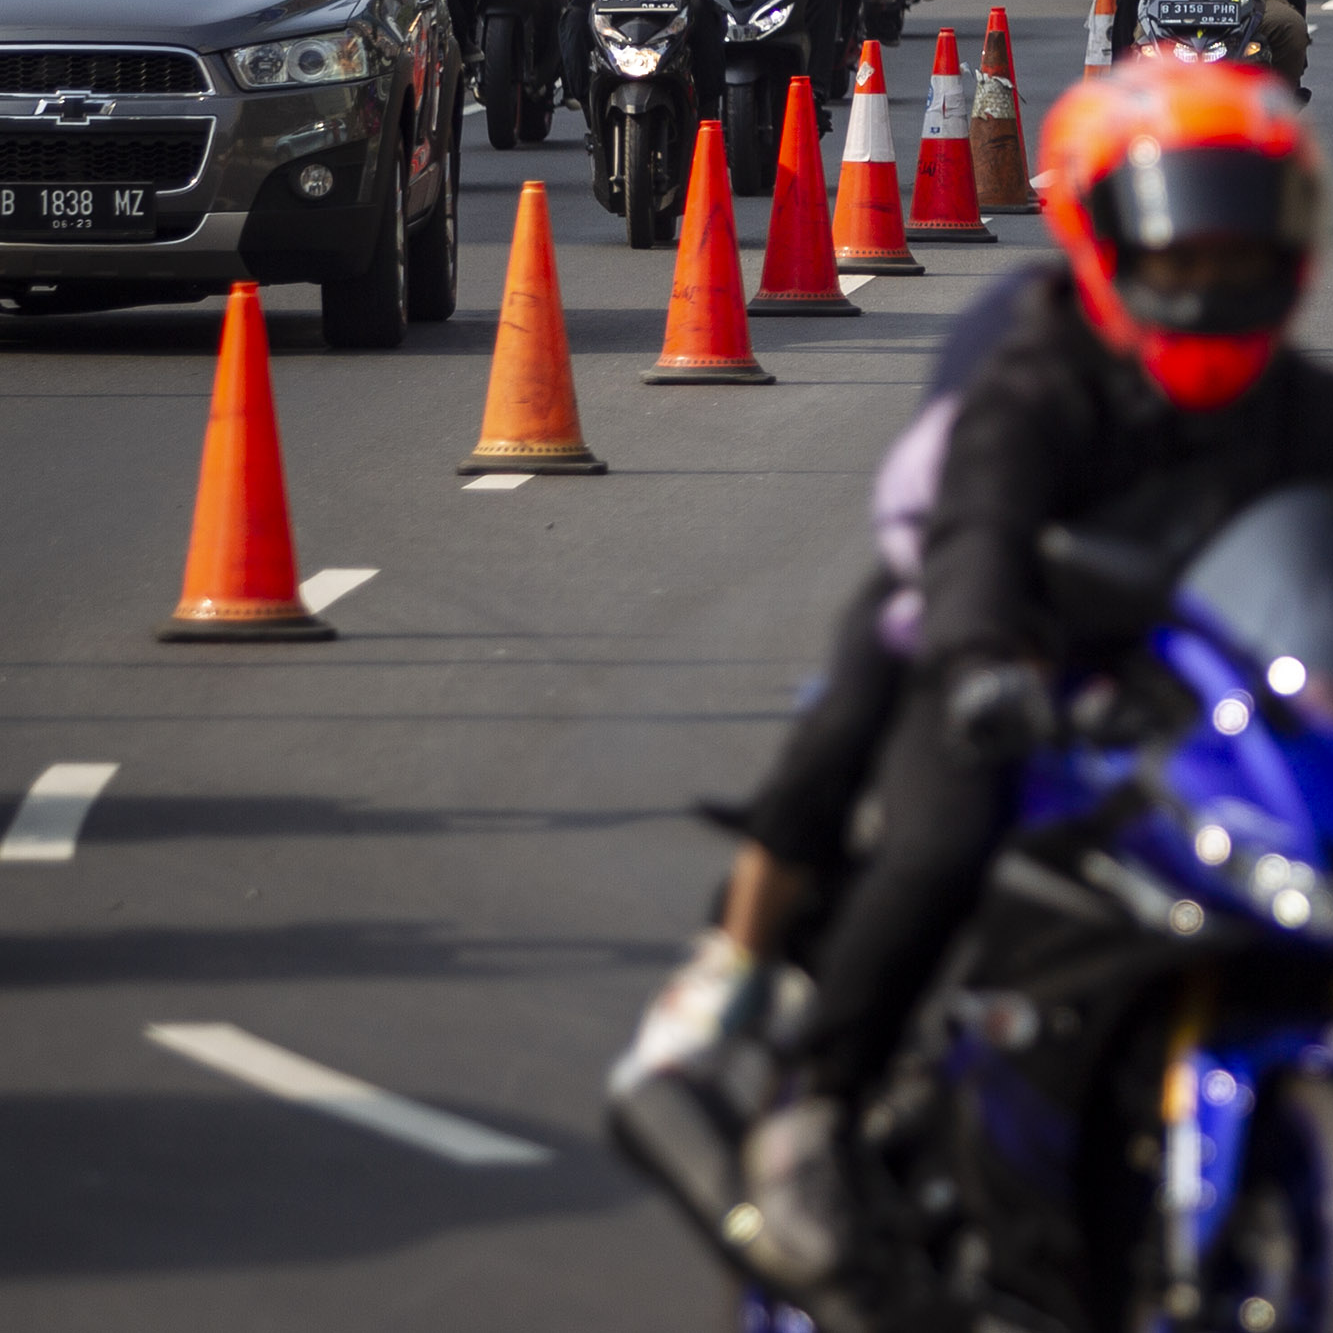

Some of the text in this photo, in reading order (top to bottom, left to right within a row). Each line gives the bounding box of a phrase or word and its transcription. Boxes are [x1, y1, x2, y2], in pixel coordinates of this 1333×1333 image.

[1161, 4, 1235, 14] B 3158 PHR
[1, 189, 145, 215] B 1838 MZ
[52, 218, 92, 228] 06-23
